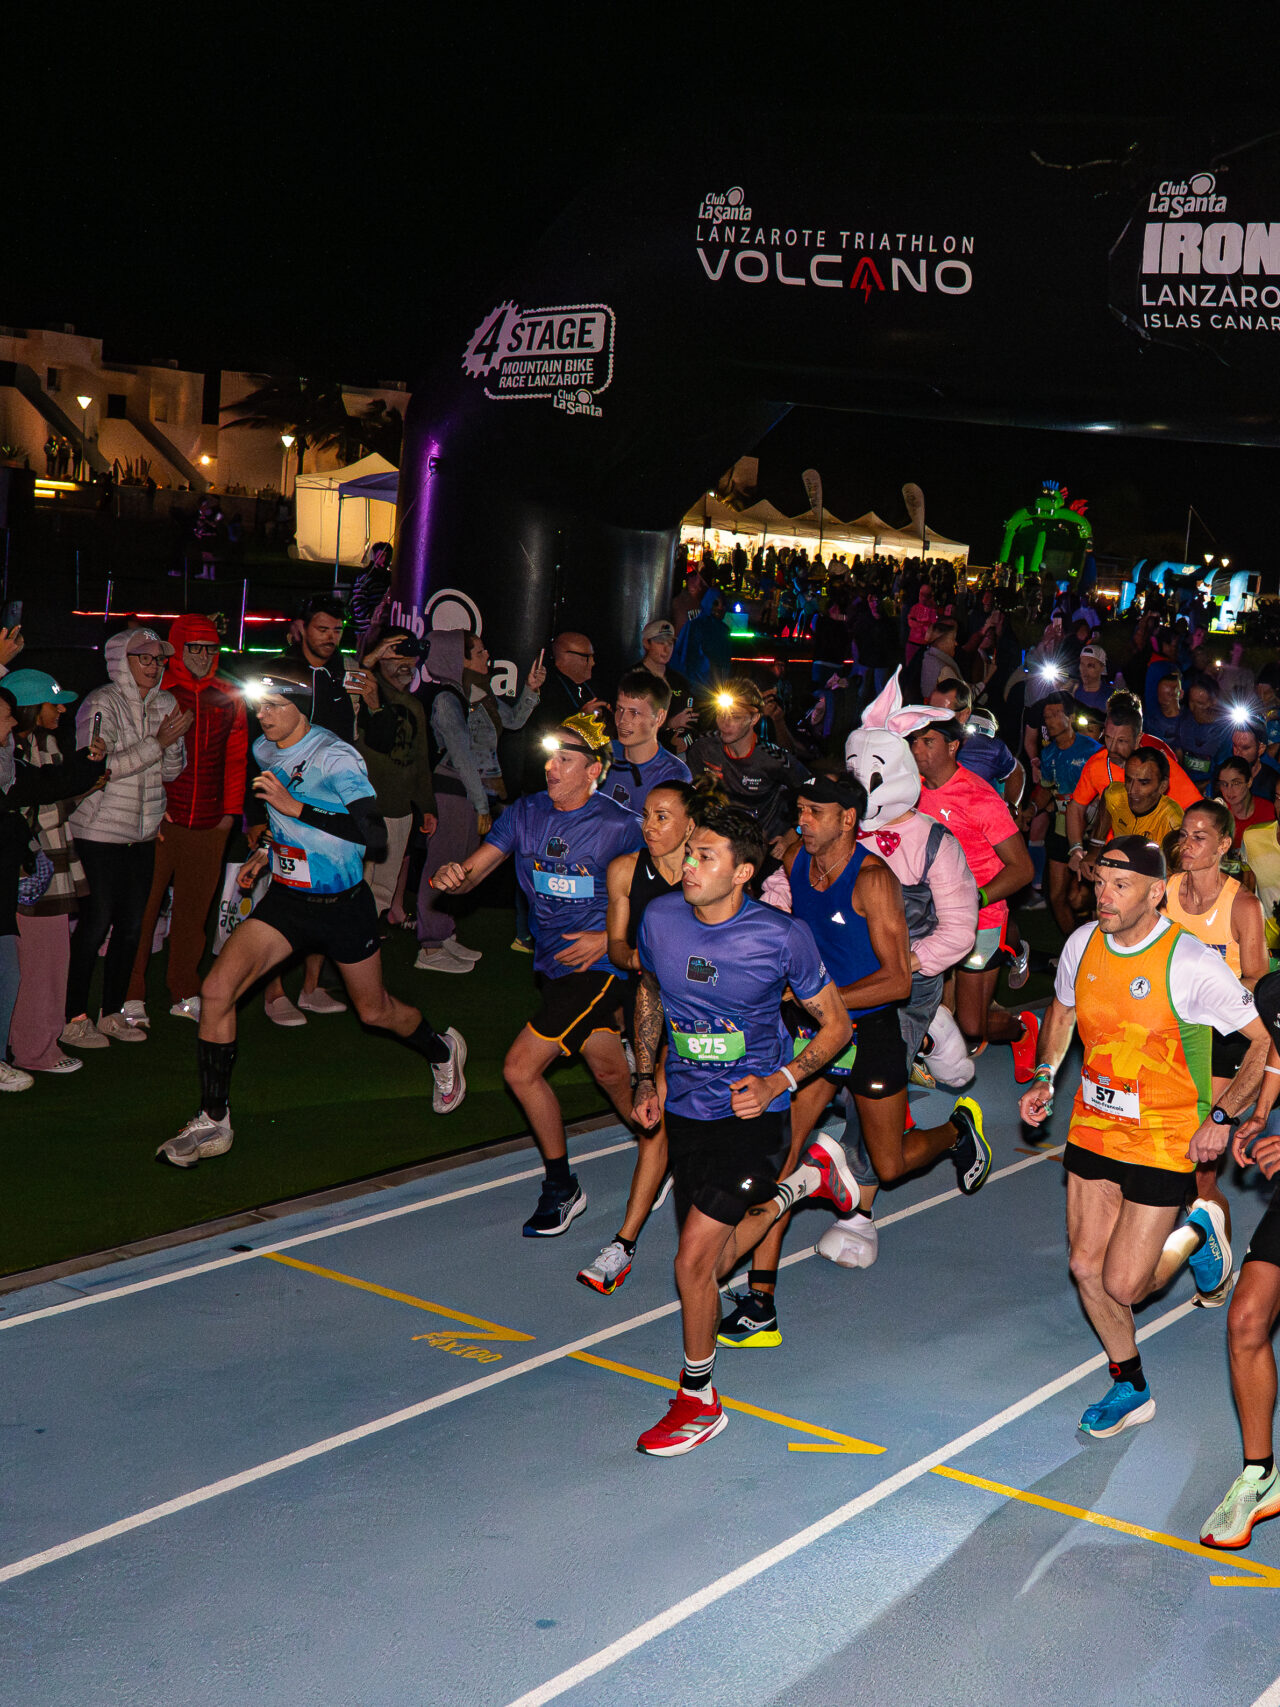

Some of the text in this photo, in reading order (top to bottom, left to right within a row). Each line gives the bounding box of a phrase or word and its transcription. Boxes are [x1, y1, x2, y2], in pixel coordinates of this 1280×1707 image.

[1159, 180, 1188, 195] Club
[705, 193, 726, 205] Club
[696, 225, 975, 254] LANZAROTE TRIATHLON
[696, 247, 973, 298] VOLCANO
[1143, 313, 1201, 329] ISLAS
[472, 309, 597, 366] 4 STAGE
[501, 358, 595, 376] MOUNTAIN BIKE
[498, 372, 594, 389] RACE LANZAROTE
[558, 389, 576, 402] Club
[548, 876, 576, 894] 691
[687, 1037, 727, 1055] 875
[1095, 1085, 1116, 1104] 57
